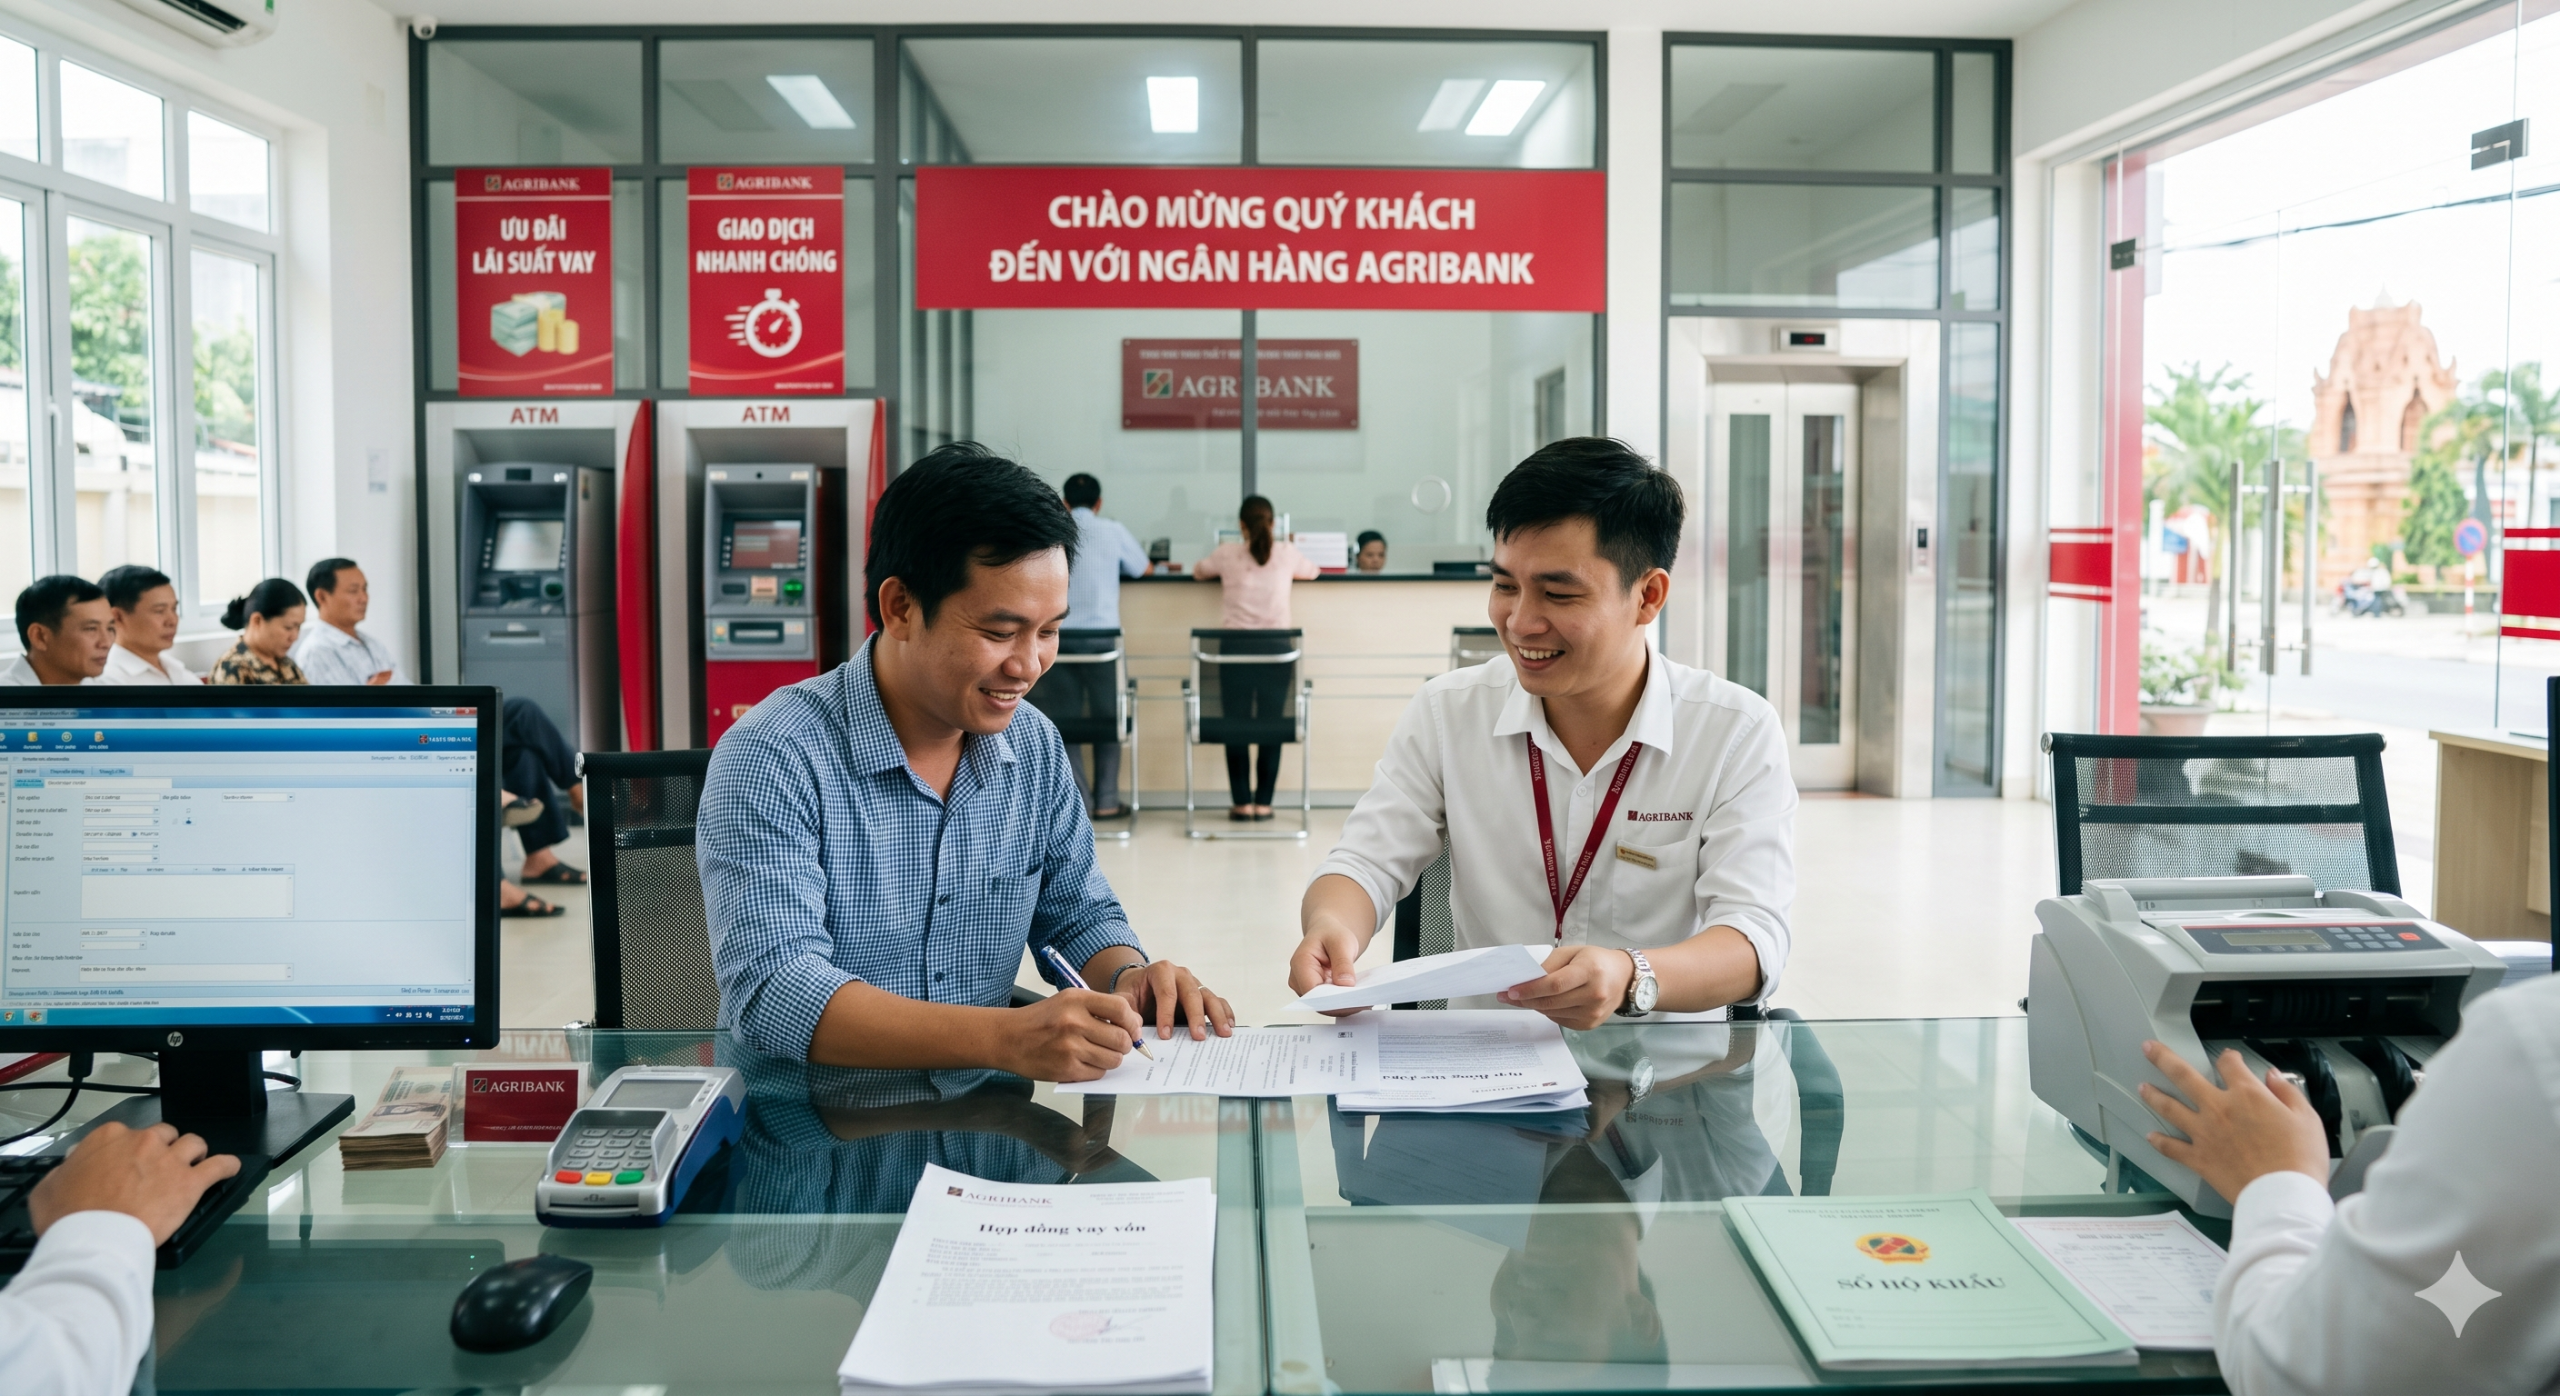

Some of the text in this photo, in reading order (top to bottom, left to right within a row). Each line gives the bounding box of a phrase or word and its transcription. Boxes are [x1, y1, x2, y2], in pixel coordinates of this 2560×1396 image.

[502, 177, 580, 192] AGRIBANK
[735, 175, 813, 190] AGRIBANK
[1048, 189, 1476, 234] CHÀO MỪNG QUÝ KHÁCH
[500, 213, 567, 241] ƯU ĐÃI
[717, 217, 814, 245] GIAO DỊCH
[472, 243, 597, 274] LÃI SUẤT VAY
[696, 245, 837, 273] NHANH CHÓNG
[988, 239, 1535, 285] ĐẾN VỚI NGÂN HÀNG AGRIBANK
[1177, 375, 1336, 398] AGRBANK
[510, 406, 559, 424] ATM
[741, 405, 790, 423] ATM
[1638, 811, 1694, 822] AGRIBANK
[169, 1033, 182, 1046] hp
[489, 1081, 565, 1093] AGRIBANK
[965, 1192, 1053, 1205] AGRIBANK
[1077, 1226, 1108, 1236] vay
